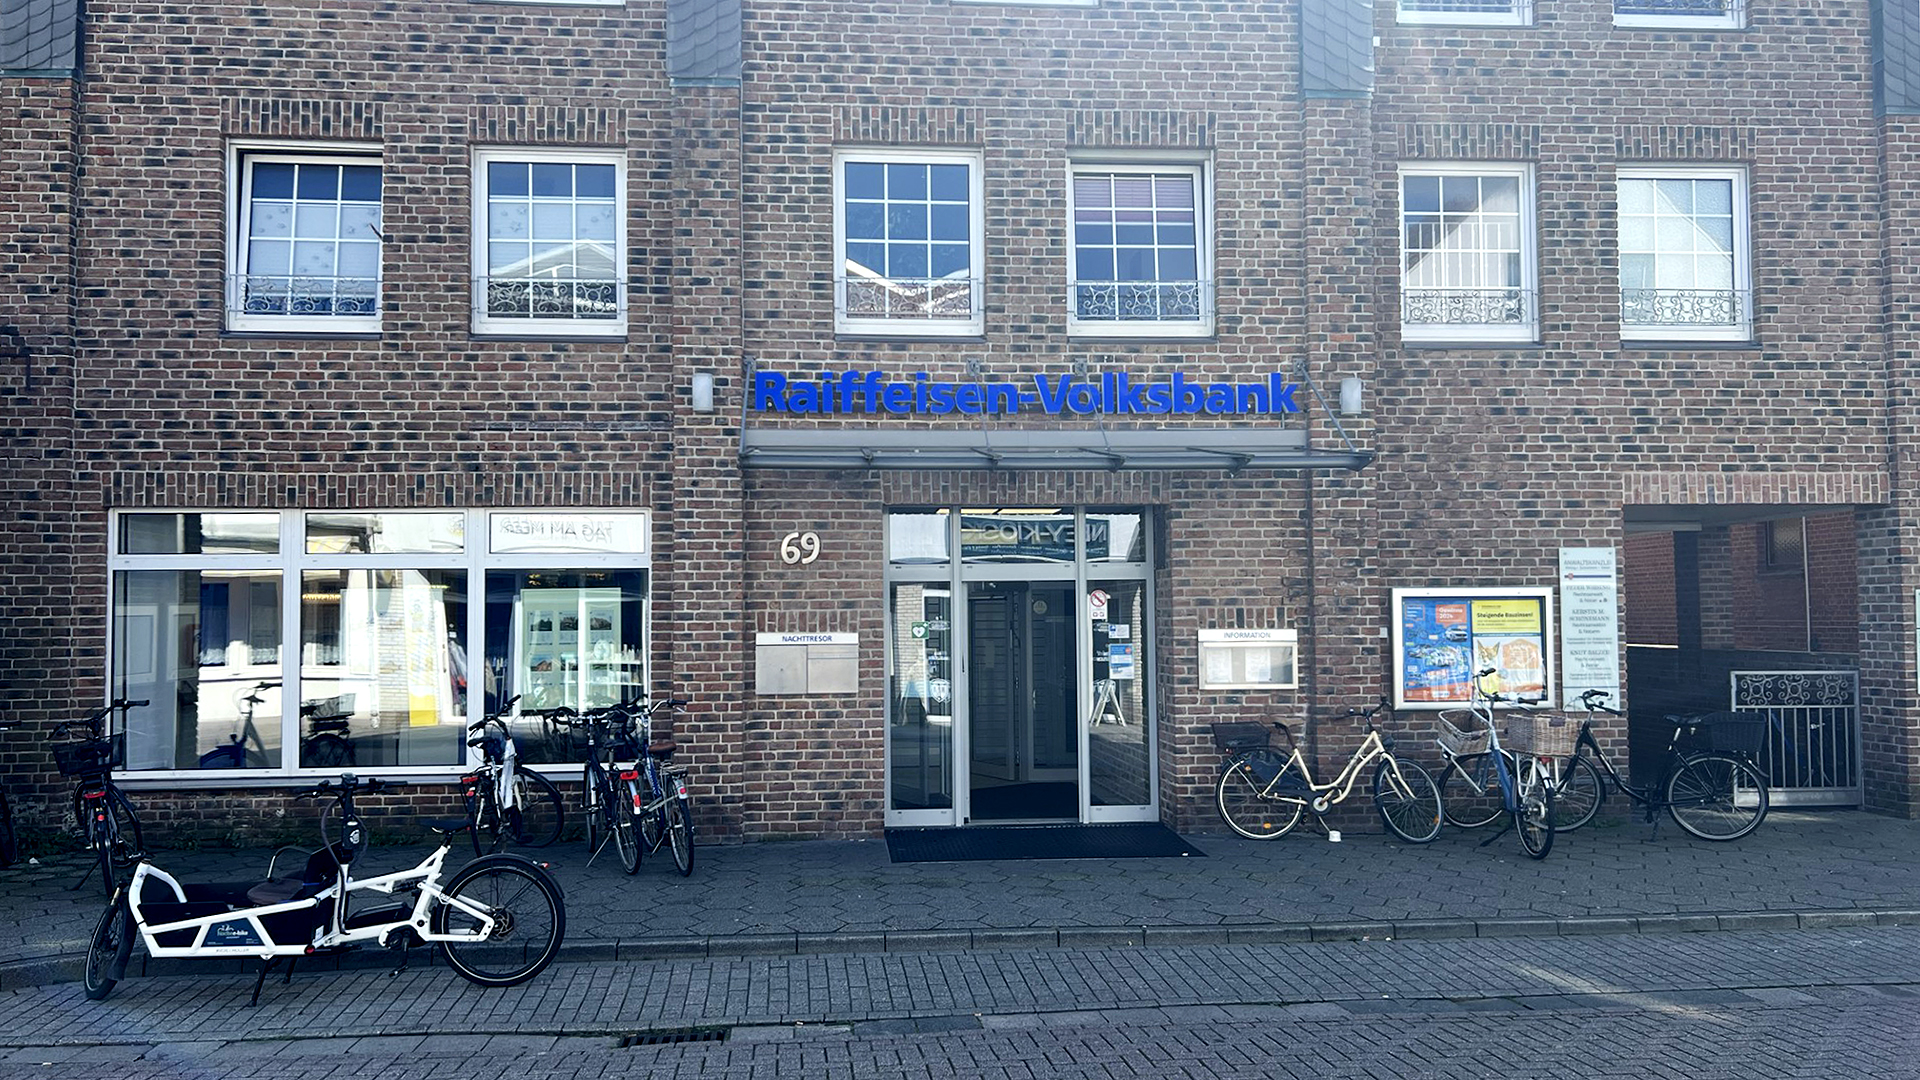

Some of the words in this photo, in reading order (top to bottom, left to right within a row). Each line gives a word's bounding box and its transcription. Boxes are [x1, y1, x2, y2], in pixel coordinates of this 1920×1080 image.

[755, 371, 1300, 415] Raiffeisen-Volksbank
[780, 531, 821, 565] 69
[782, 635, 833, 643] NACHTTRESOR
